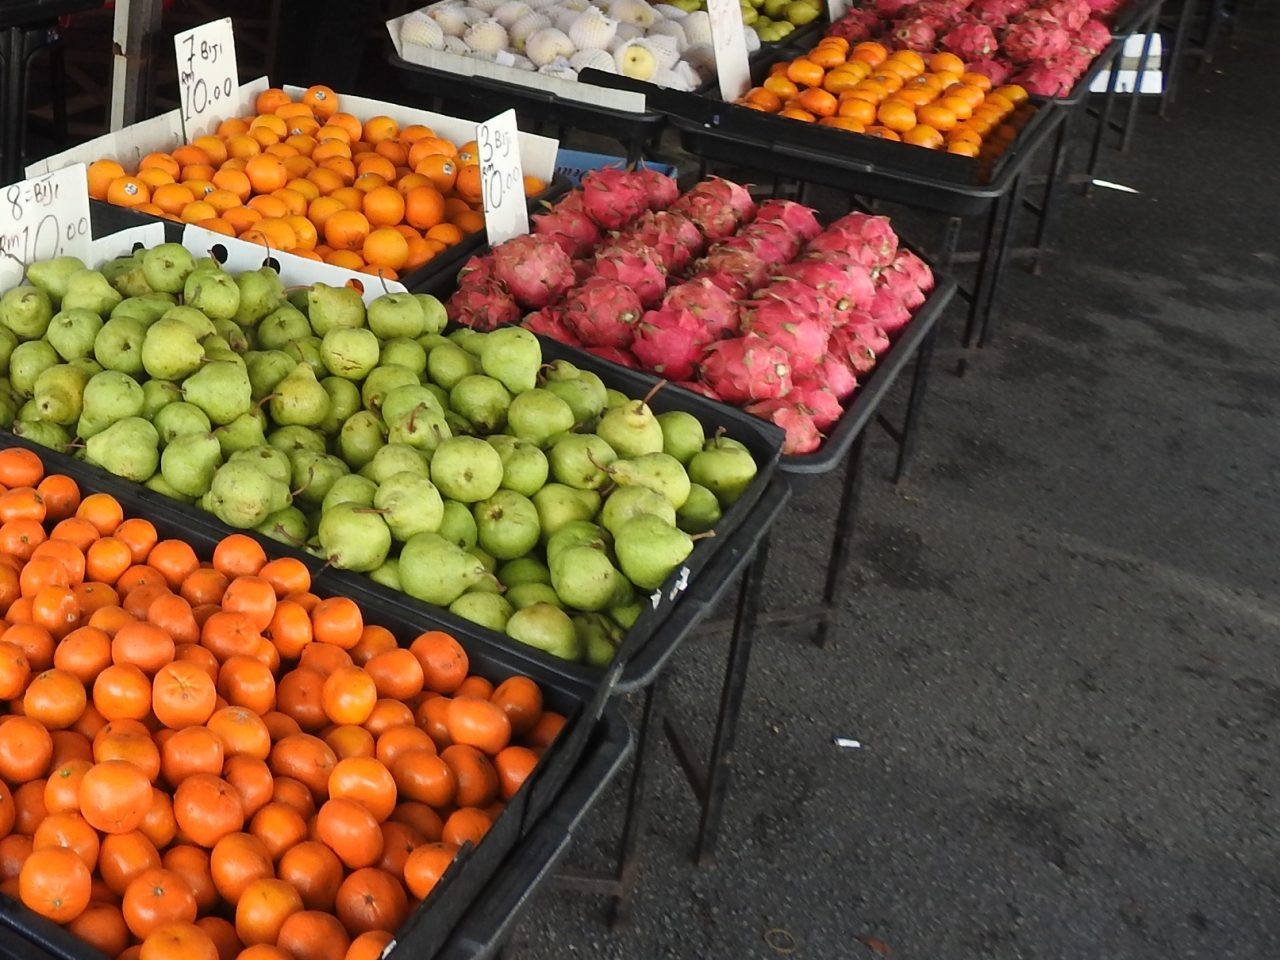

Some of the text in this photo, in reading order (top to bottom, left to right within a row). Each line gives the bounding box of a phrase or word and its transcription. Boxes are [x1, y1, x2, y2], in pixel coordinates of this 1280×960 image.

[185, 77, 232, 122] 10.00
[481, 125, 493, 162] 3
[6, 184, 23, 221] 8
